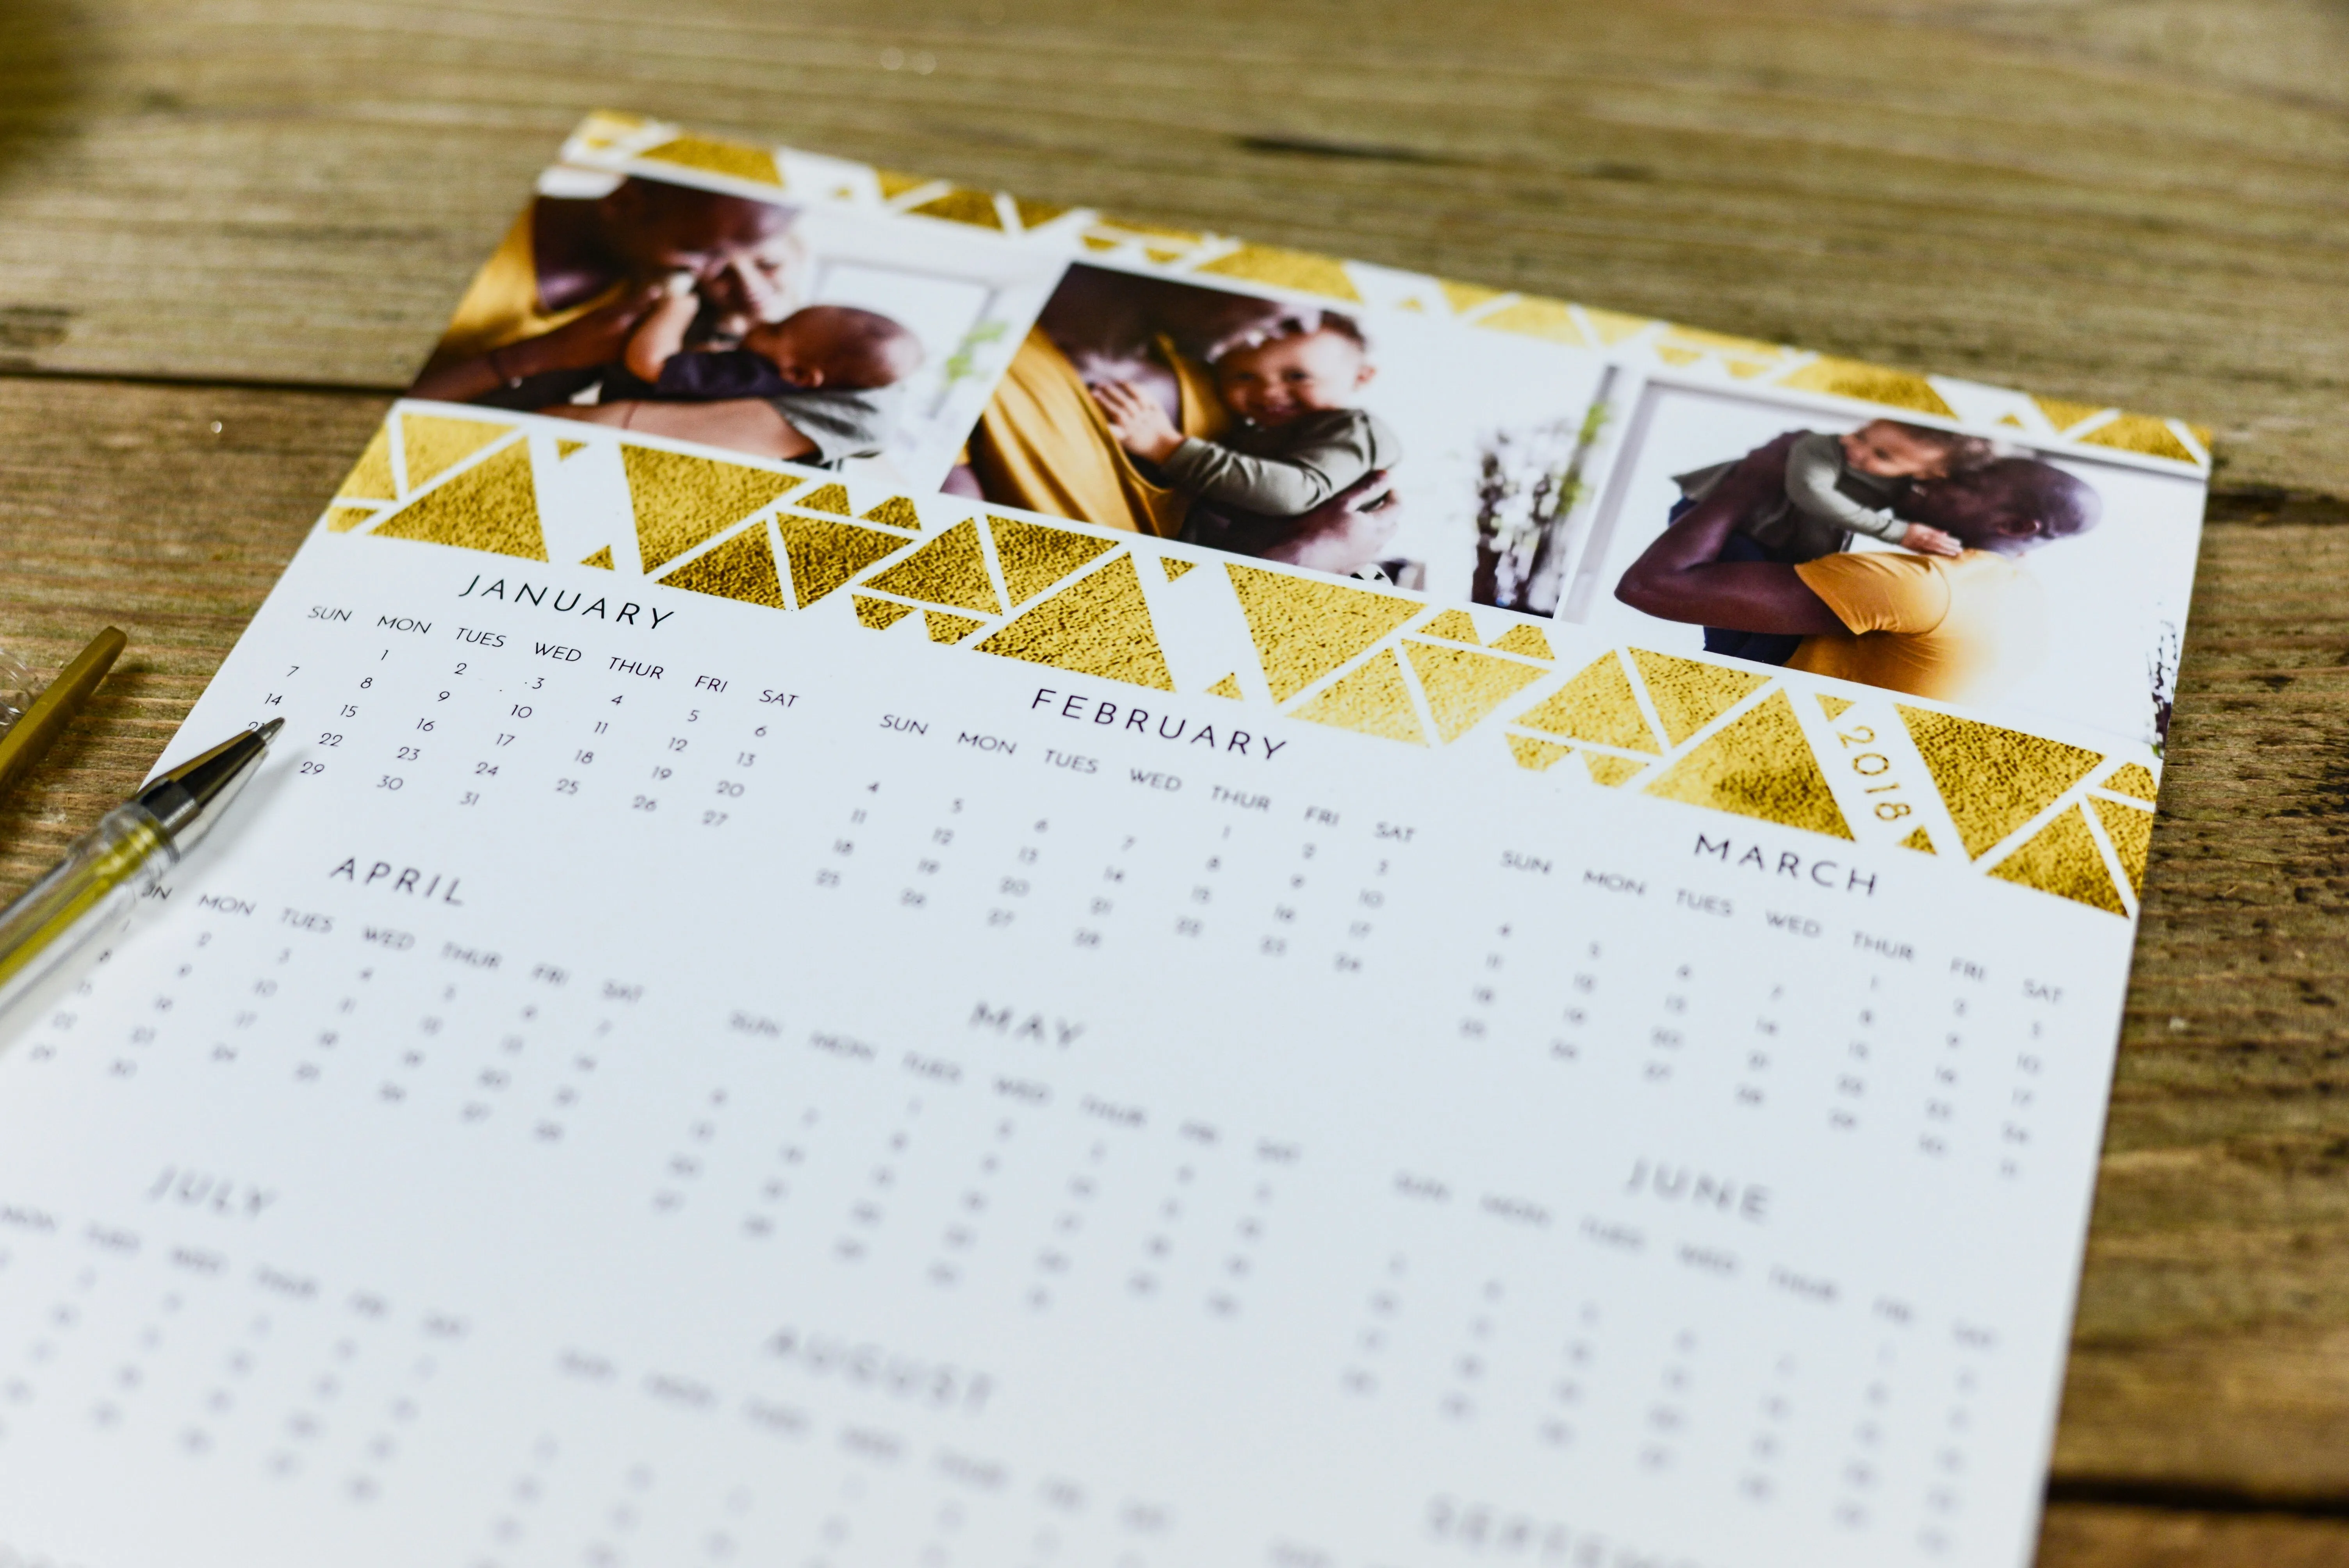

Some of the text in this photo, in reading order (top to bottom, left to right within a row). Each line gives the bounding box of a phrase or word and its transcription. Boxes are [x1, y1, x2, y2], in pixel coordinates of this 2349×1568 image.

[459, 574, 674, 630] JANUARY
[308, 606, 799, 707] SUN MON TUES WED THUR FRI SAT
[287, 666, 756, 767] 7 8 9 10 11 12 13
[381, 649, 766, 737] 1 2 3 4 5 6
[1032, 688, 1287, 761] FEBRUARY
[265, 693, 745, 798] 14 15 16 17 18 19 20
[318, 732, 343, 747] 22
[396, 746, 421, 761] 23
[475, 762, 499, 777] 24
[555, 778, 580, 795] 25
[880, 714, 1415, 843] SUN MON TUES WED THUR FRI SAT
[1836, 725, 1912, 821] 2018
[300, 761, 480, 806] 29 30 31
[850, 808, 868, 825] 11
[868, 782, 879, 793] 4
[330, 855, 464, 907] APRIL
[1694, 832, 1880, 896] MARCH
[197, 893, 256, 916] MON
[281, 907, 334, 934] TUES
[362, 926, 415, 950] WED
[441, 941, 503, 970] THUR
[1500, 850, 1552, 875] SUN
[1583, 869, 1647, 896] MON
[1676, 888, 1734, 918] TUES
[1766, 911, 1822, 938] WED
[1853, 930, 1915, 962] THUR
[1950, 957, 1986, 982] FRI
[968, 1000, 1086, 1049] MAY
[1624, 1155, 1774, 1225] JUNE
